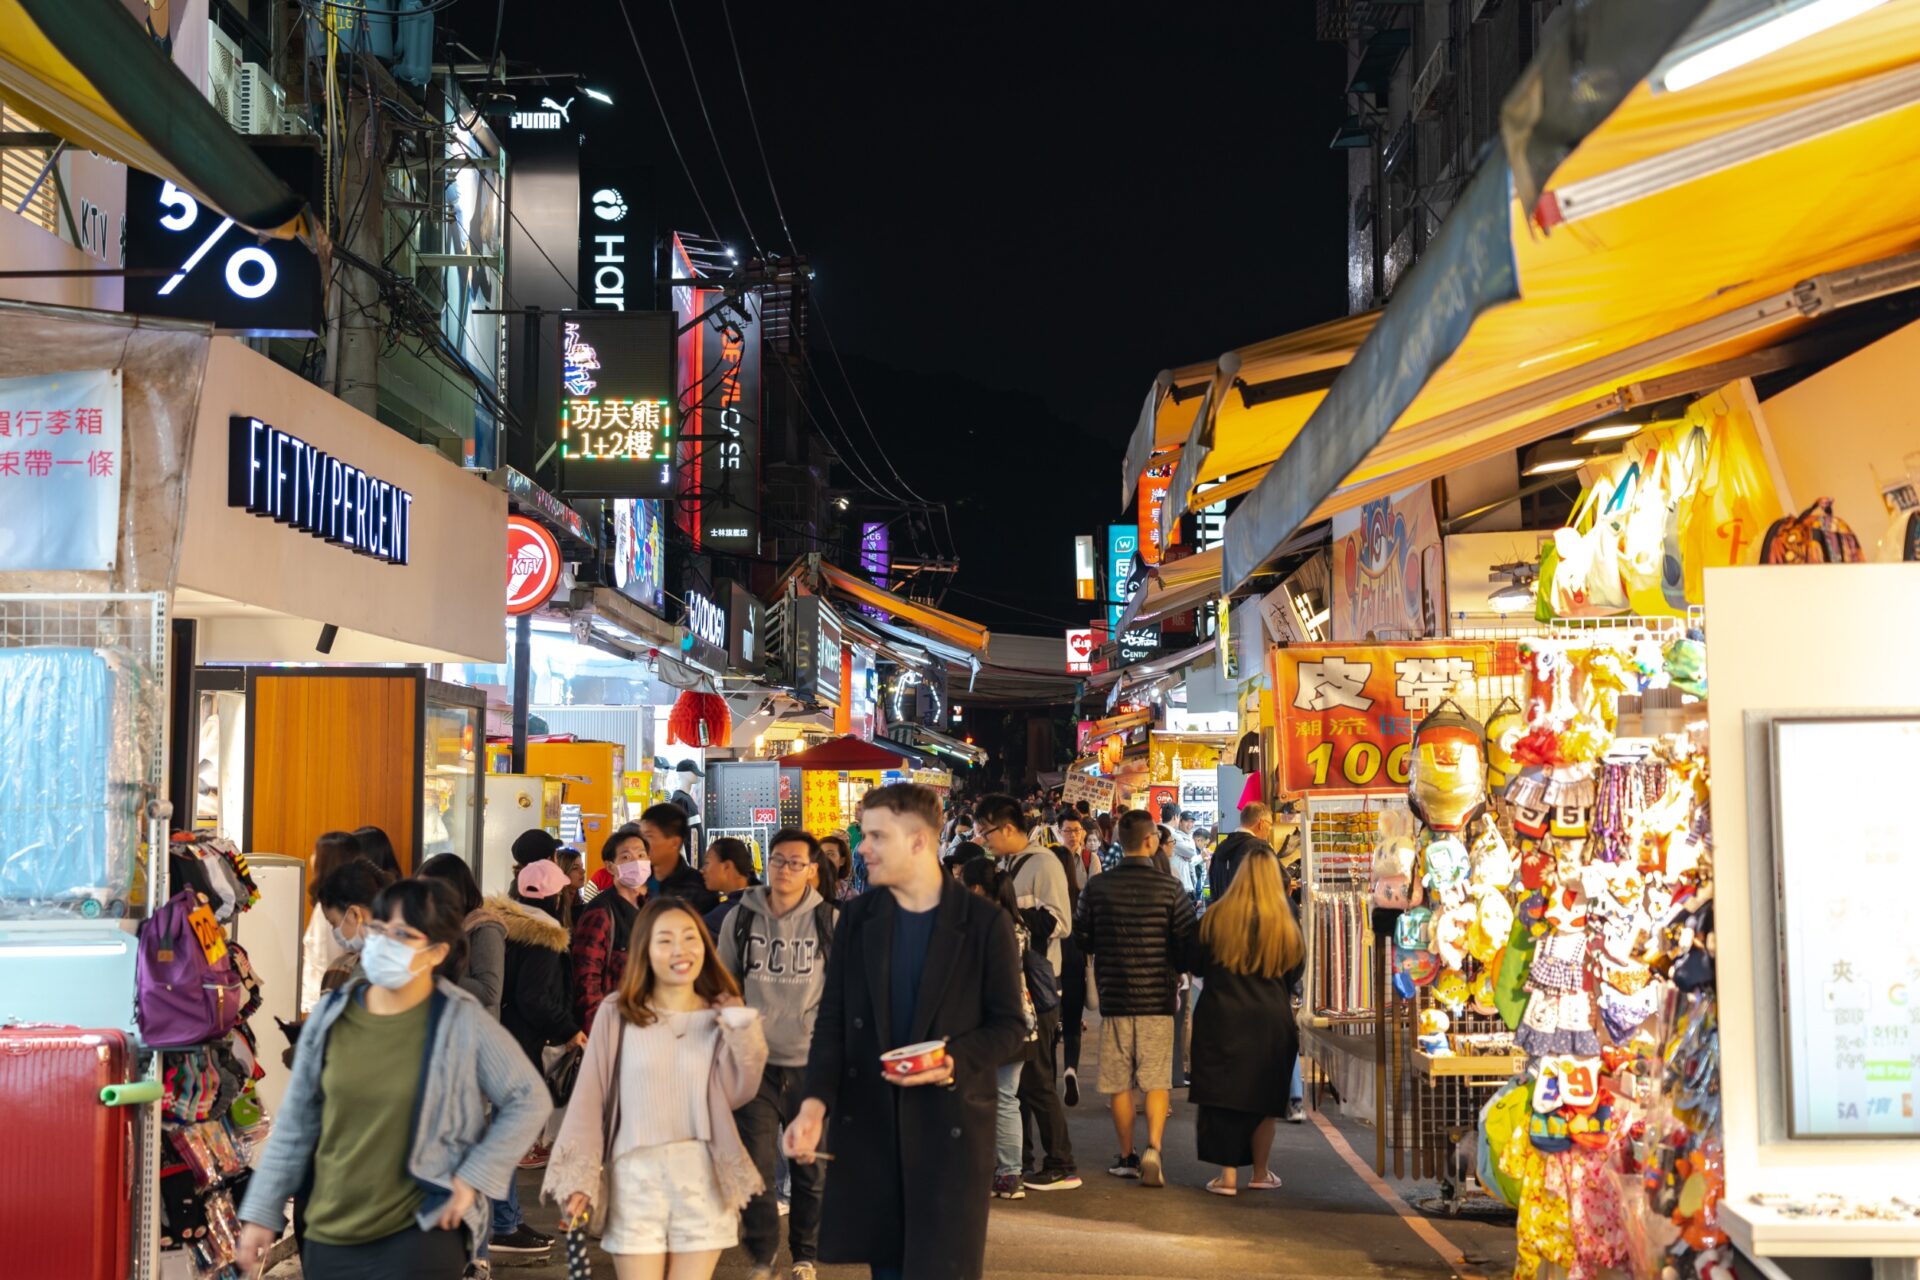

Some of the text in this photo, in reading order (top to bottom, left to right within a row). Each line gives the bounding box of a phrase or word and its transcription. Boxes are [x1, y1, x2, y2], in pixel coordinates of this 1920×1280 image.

[511, 112, 561, 129] PUMA
[571, 402, 661, 430] 功夫熊
[580, 431, 653, 458] 1+2樓
[719, 407, 741, 469] CASE
[249, 418, 413, 566] FIFTY/PERCENT
[710, 528, 749, 537] 士林旗艦店
[511, 558, 544, 575] KTV
[1293, 656, 1476, 714] 皮帶
[757, 812, 773, 821] 290
[1562, 806, 1579, 824] 5
[744, 934, 815, 975] CCU
[1567, 1066, 1594, 1098] 9
